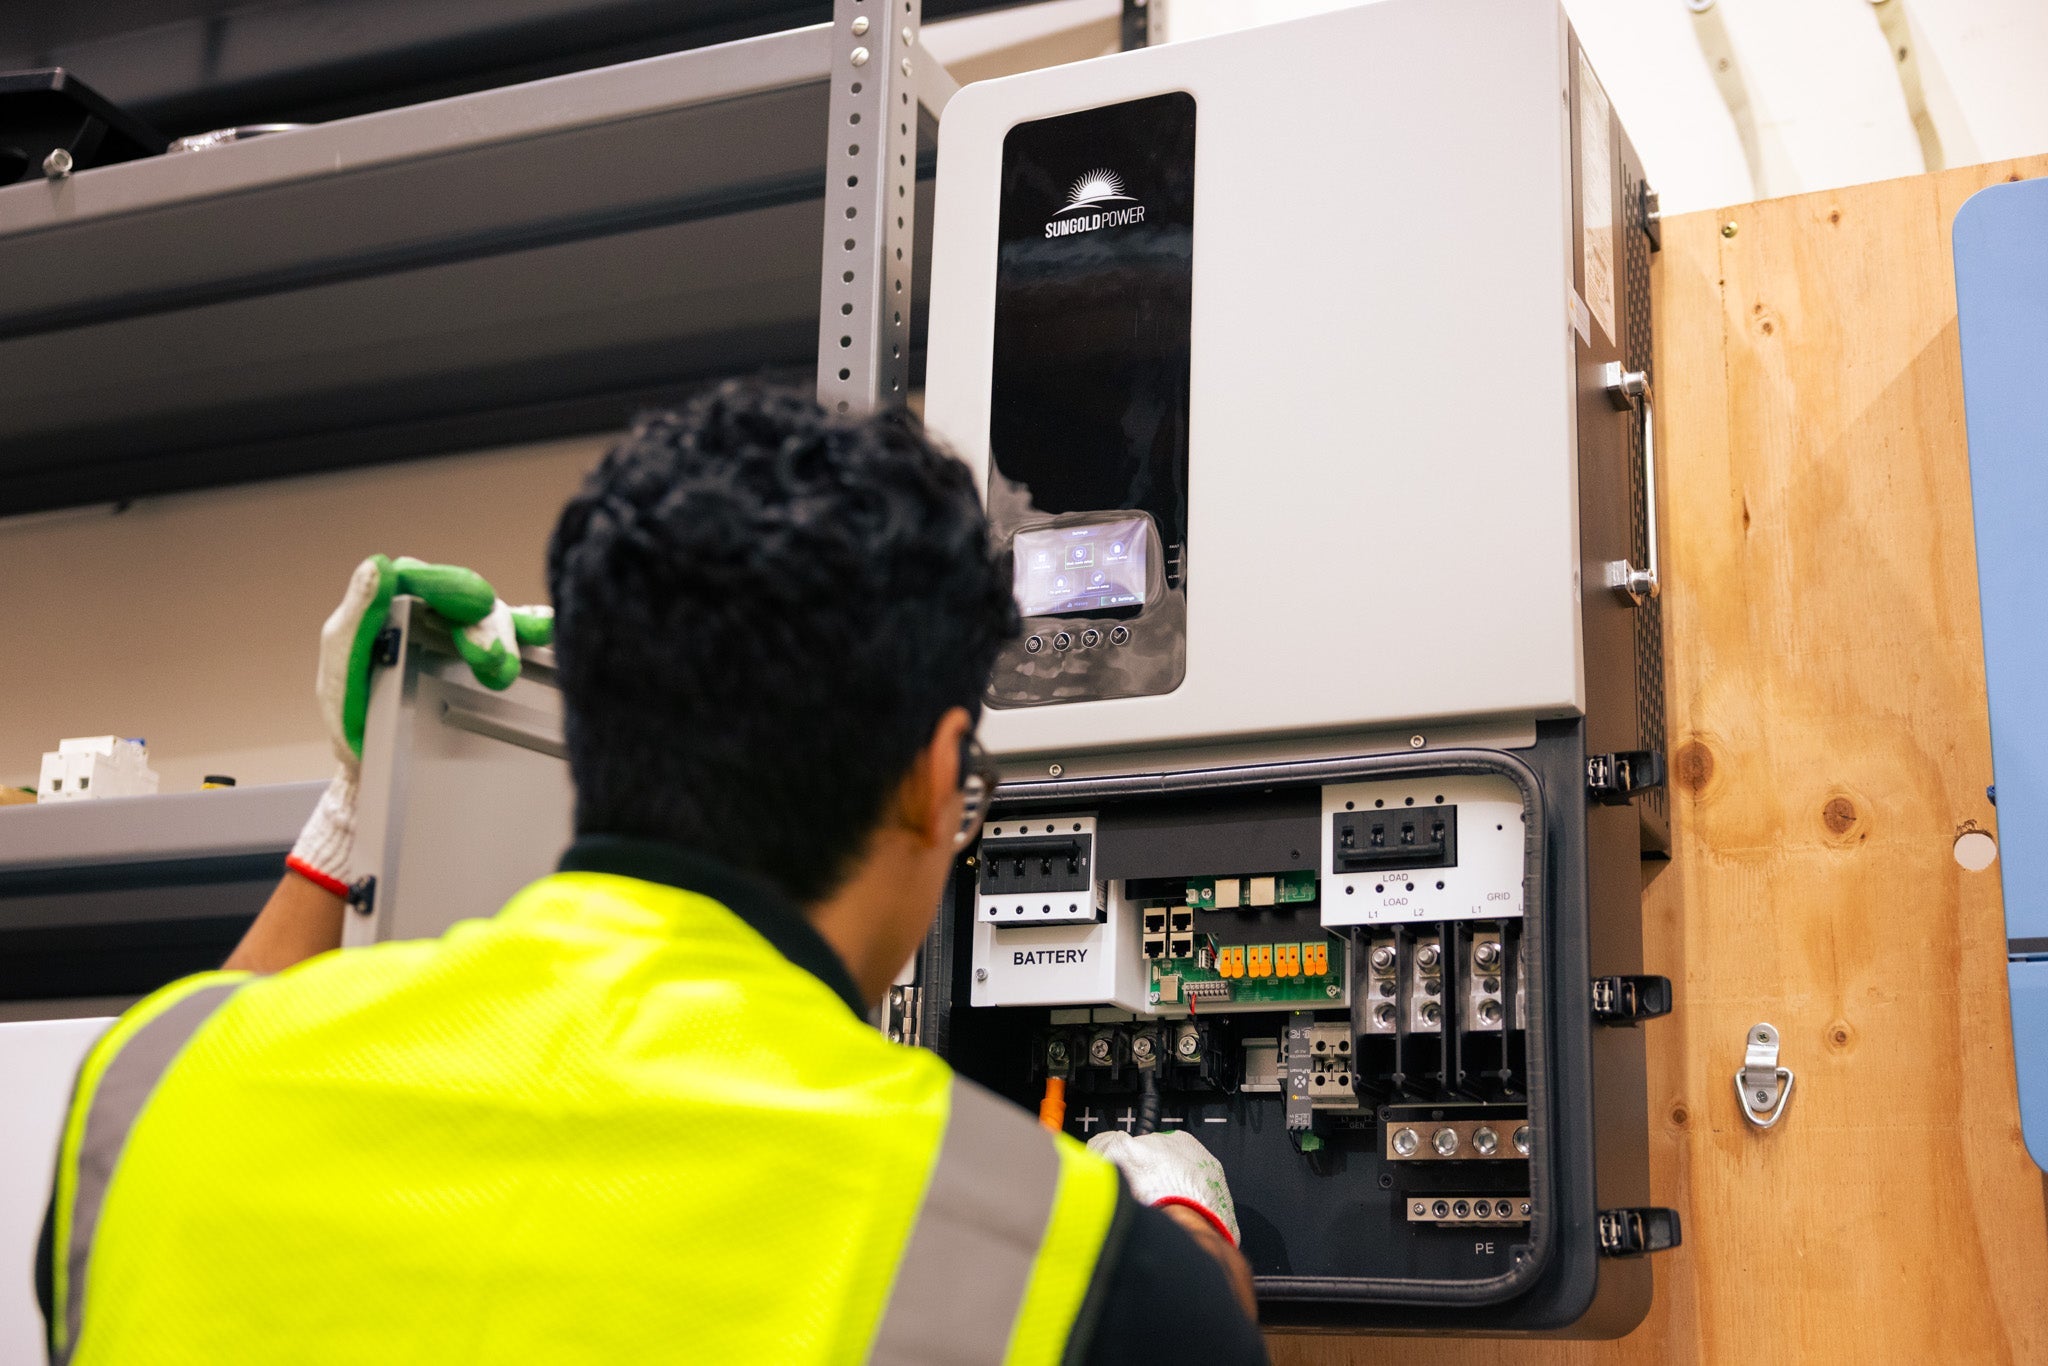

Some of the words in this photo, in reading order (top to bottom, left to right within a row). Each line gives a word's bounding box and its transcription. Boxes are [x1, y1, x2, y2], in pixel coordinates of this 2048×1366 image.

[1044, 206, 1145, 239] SUNGOLDPOWER
[1382, 873, 1409, 883] LOAD
[1486, 892, 1511, 902] GRID
[1383, 898, 1409, 907] LOAD
[1368, 911, 1378, 919] L1
[1413, 908, 1425, 918] L2
[1471, 905, 1482, 914] L1
[1013, 949, 1088, 966] BATTERY
[1475, 1242, 1495, 1254] PE
